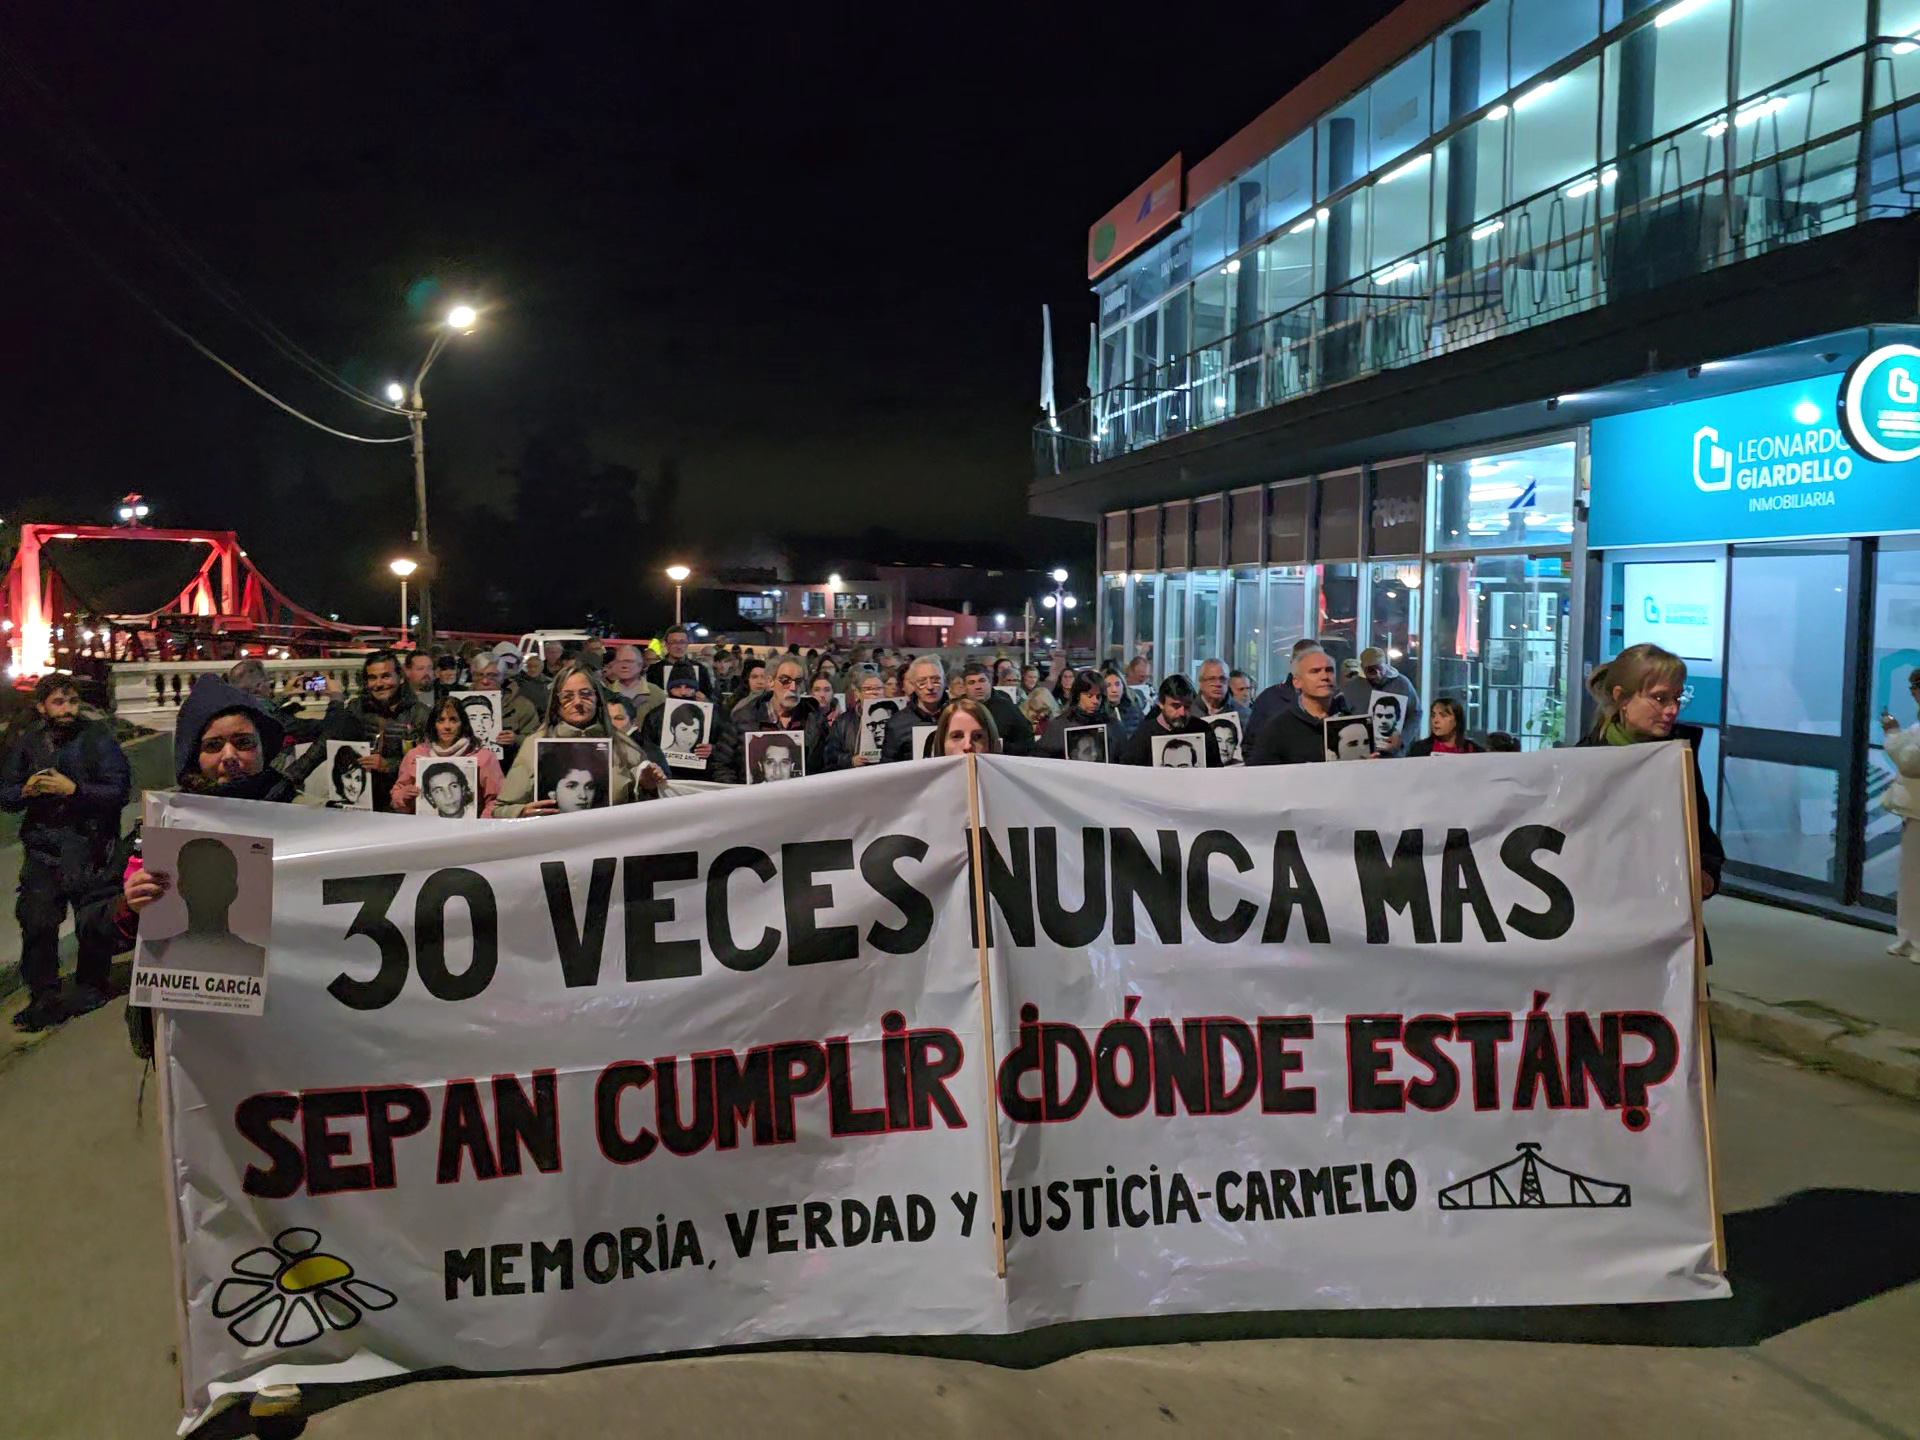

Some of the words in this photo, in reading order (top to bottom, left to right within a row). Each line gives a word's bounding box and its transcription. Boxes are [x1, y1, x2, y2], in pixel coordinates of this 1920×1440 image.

[1736, 456, 1853, 490] GIARDELLO
[1749, 491, 1836, 512] INMOBILIARIA
[323, 868, 498, 1011] 30
[540, 834, 935, 989] VECES
[965, 826, 1332, 949] NUNCA
[1353, 825, 1576, 945] MAS
[135, 971, 200, 990] MANUEL
[205, 977, 262, 996] GARCÍA
[235, 1067, 563, 1198] SEPAN
[594, 1009, 968, 1167] CUMPLIR
[996, 996, 1317, 1123] ¿DÓNDE
[1346, 990, 1680, 1132] ESTÁN?
[724, 1193, 936, 1259] VERDAD
[950, 1190, 978, 1238] Y
